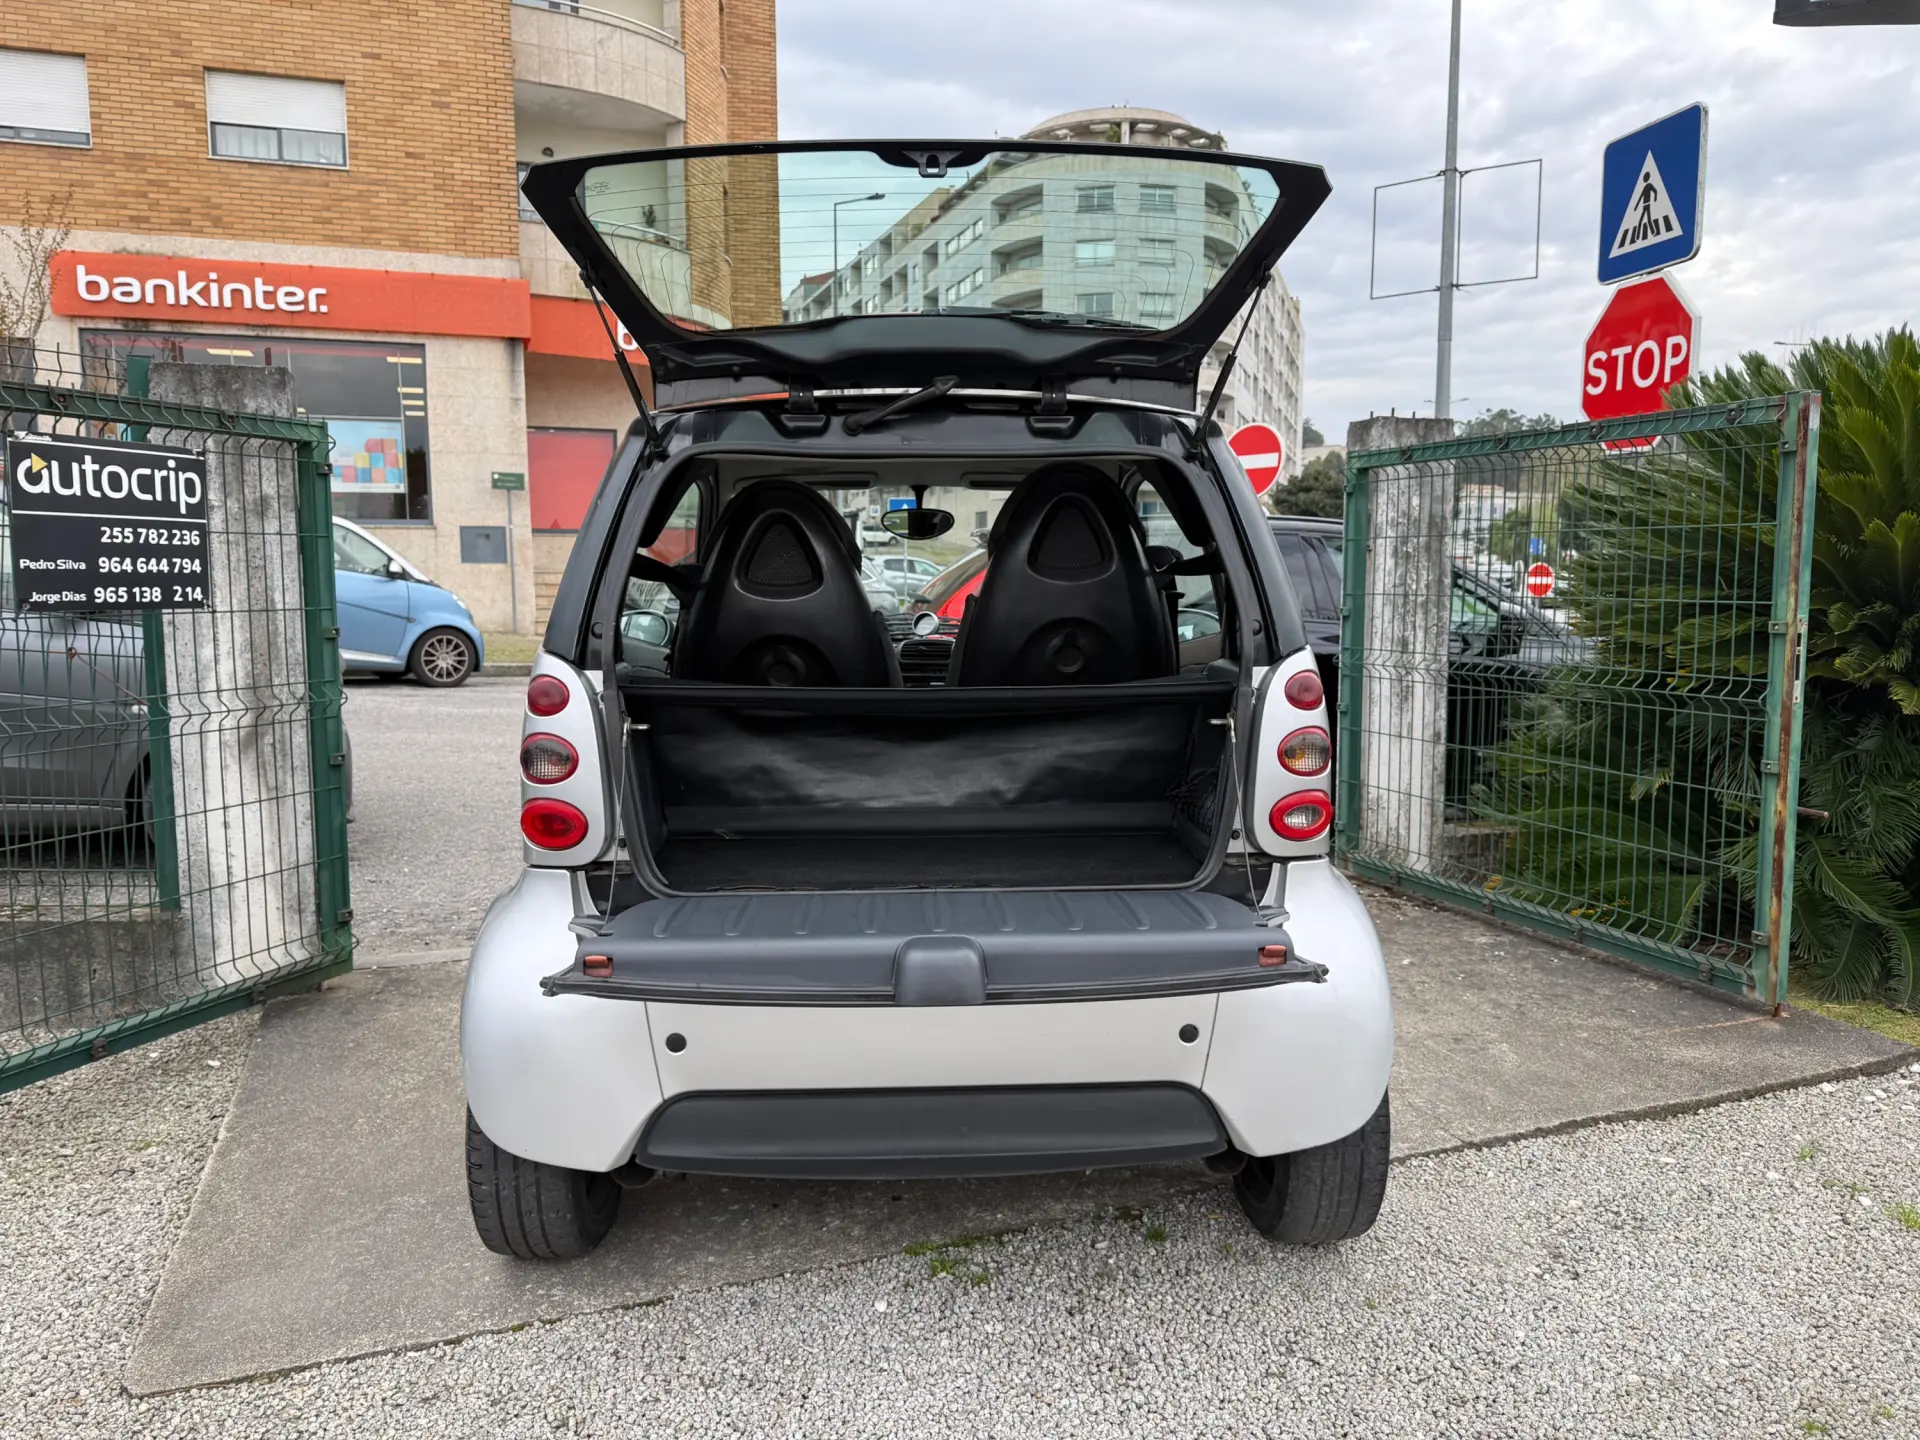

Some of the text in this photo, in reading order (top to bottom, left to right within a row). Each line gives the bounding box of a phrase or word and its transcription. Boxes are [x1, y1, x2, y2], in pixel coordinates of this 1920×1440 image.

[1585, 335, 1688, 396] STOP
[16, 453, 202, 515] autocrip
[100, 526, 200, 546] 255 782 236
[19, 557, 201, 573] Pedro Silva 964 644 794
[29, 586, 203, 603] Jorge Dias 965 138 214
